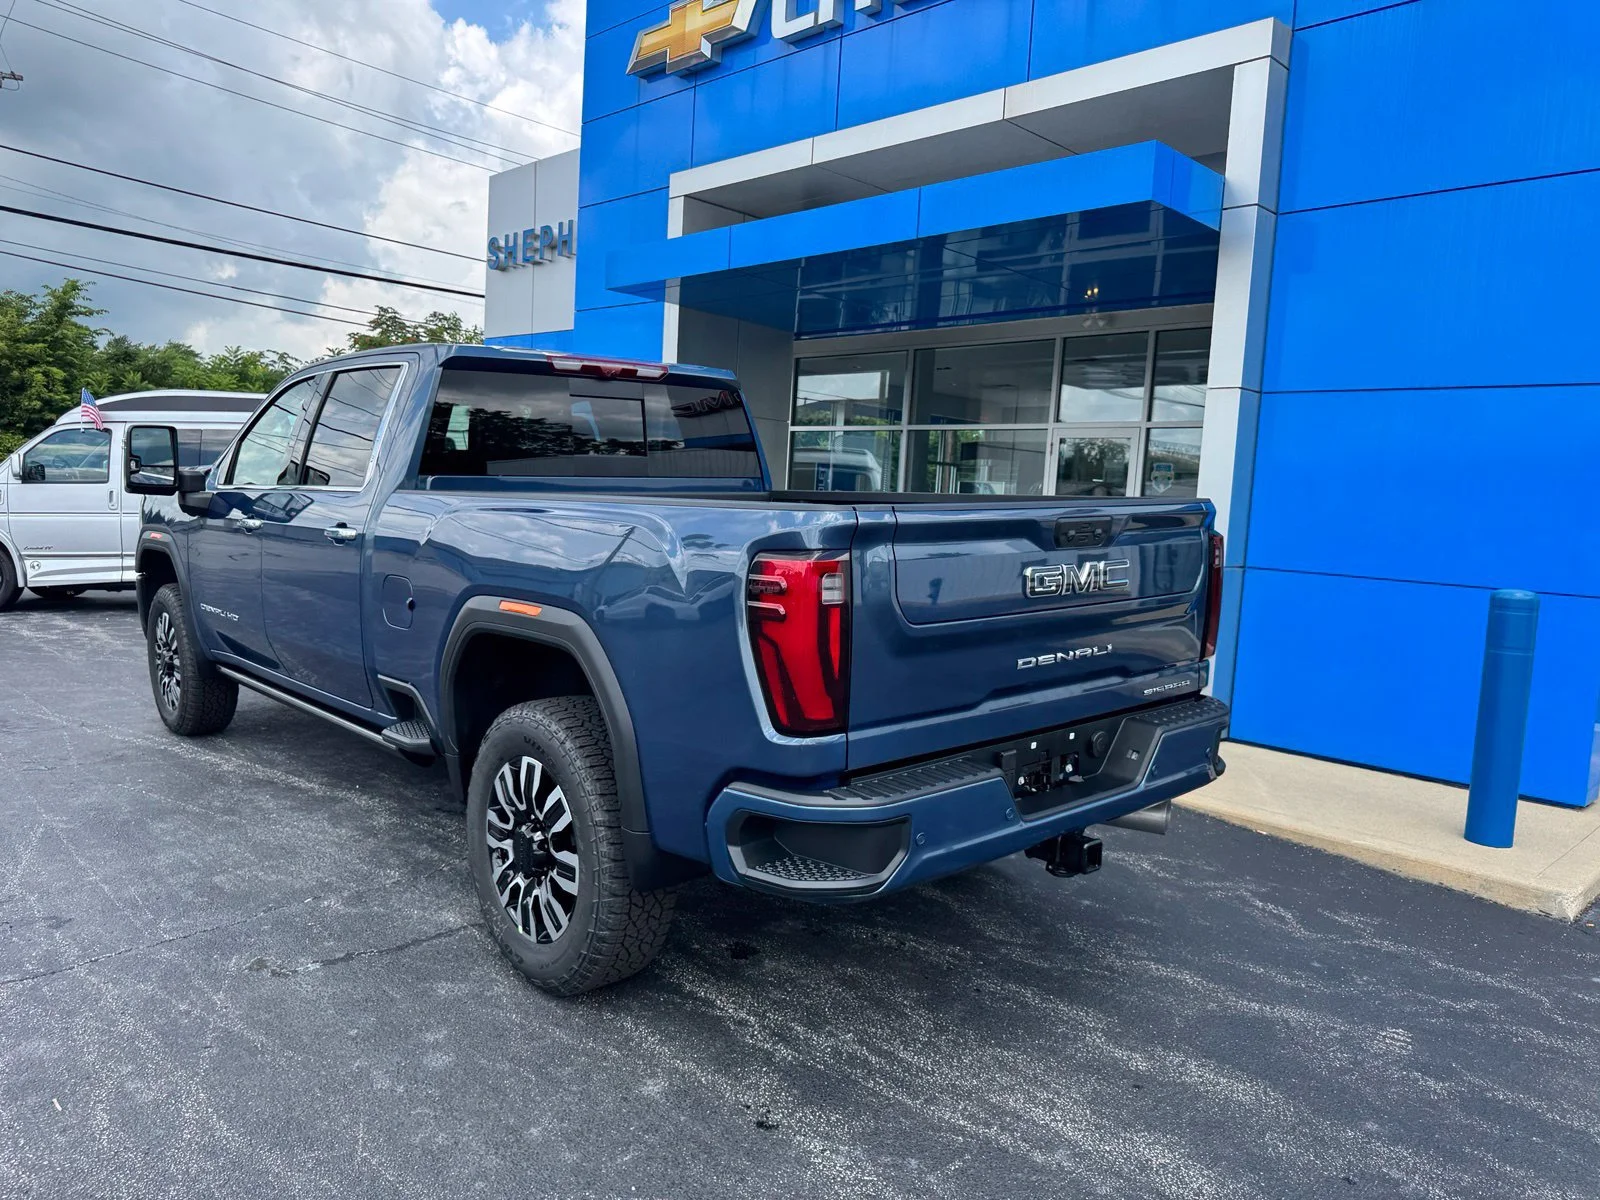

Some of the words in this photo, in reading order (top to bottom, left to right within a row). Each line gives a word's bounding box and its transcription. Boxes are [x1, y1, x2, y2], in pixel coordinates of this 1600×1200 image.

[487, 219, 575, 271] SHEPH
[1023, 559, 1130, 598] GMC
[1017, 643, 1113, 670] DENALI
